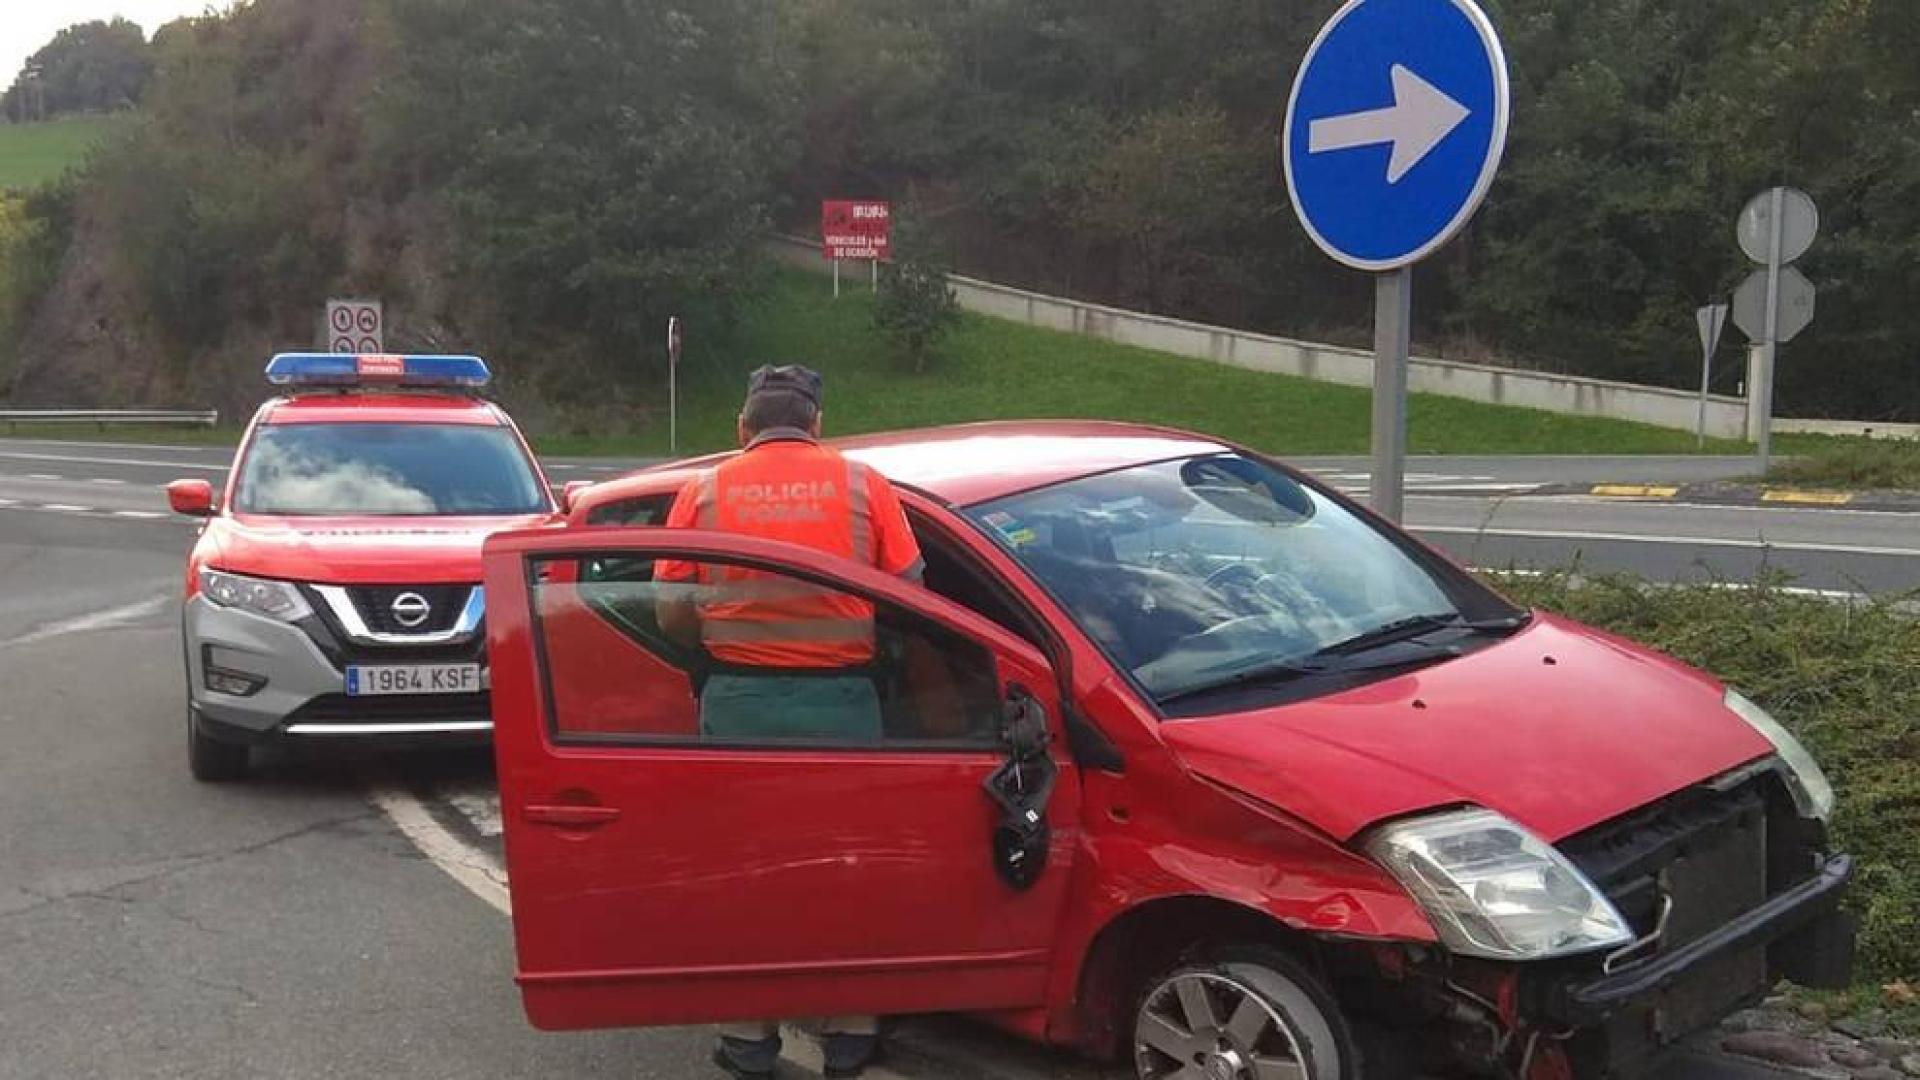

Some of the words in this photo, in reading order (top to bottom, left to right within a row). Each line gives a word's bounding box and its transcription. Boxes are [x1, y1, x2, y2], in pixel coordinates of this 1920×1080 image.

[727, 480, 837, 503] POLICIA
[367, 667, 422, 691] 1964
[431, 666, 474, 689] KSF
